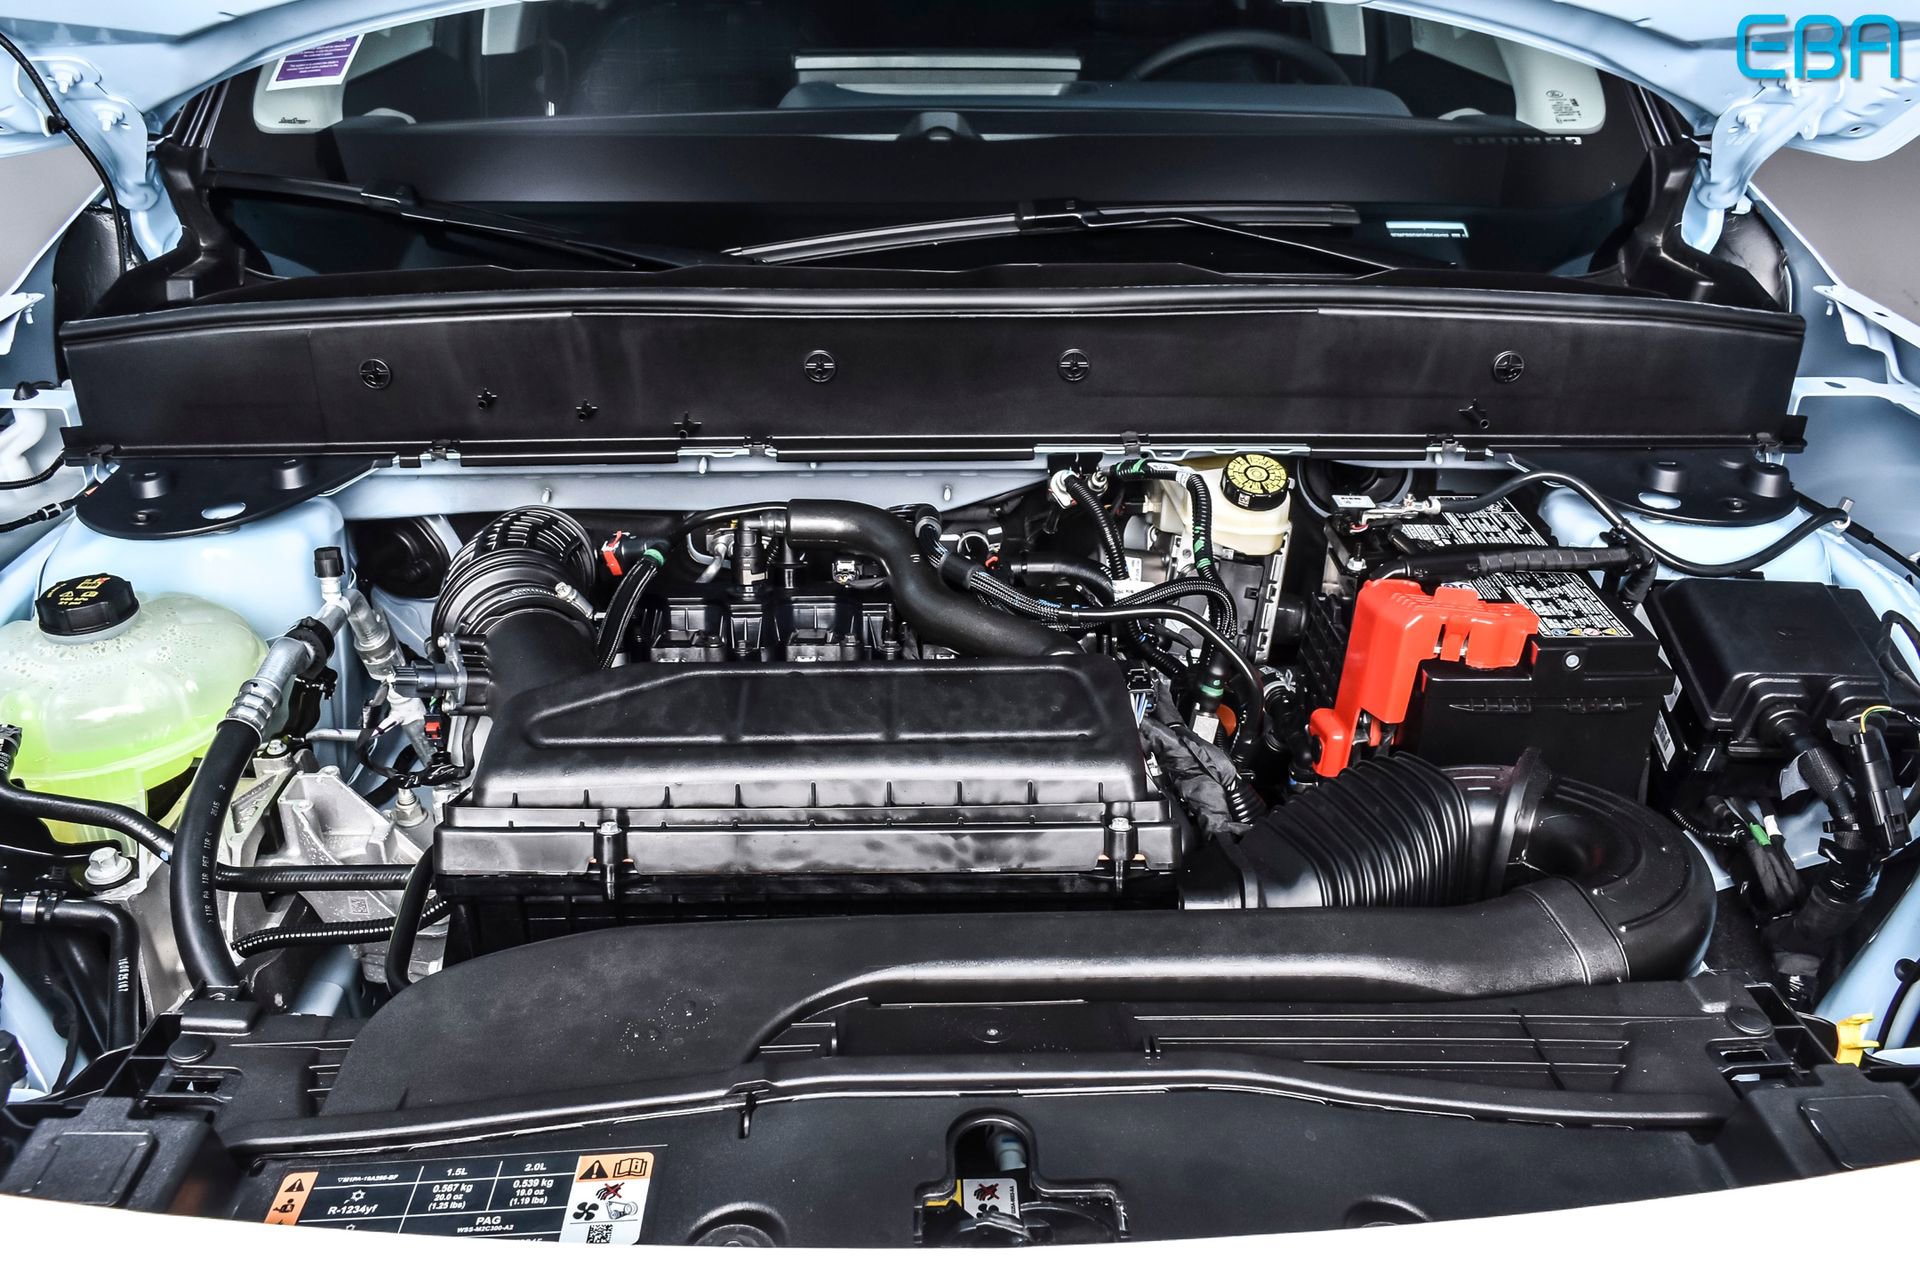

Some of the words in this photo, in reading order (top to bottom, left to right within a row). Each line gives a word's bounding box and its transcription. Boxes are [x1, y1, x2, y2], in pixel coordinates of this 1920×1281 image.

[446, 1167, 468, 1176] 1.5L
[524, 1162, 547, 1172] 2.0L
[460, 1183, 474, 1193] kg
[512, 1178, 540, 1188] 0.539
[540, 1178, 554, 1188] kg
[433, 1193, 453, 1201] 20.0
[516, 1188, 533, 1197] 19.0
[533, 1188, 545, 1196] oz
[449, 1200, 466, 1210] lbs)
[509, 1196, 531, 1207] (1.19
[531, 1196, 548, 1206] lbs)
[327, 1203, 379, 1215] R-1234yf
[475, 1215, 501, 1225] PAG
